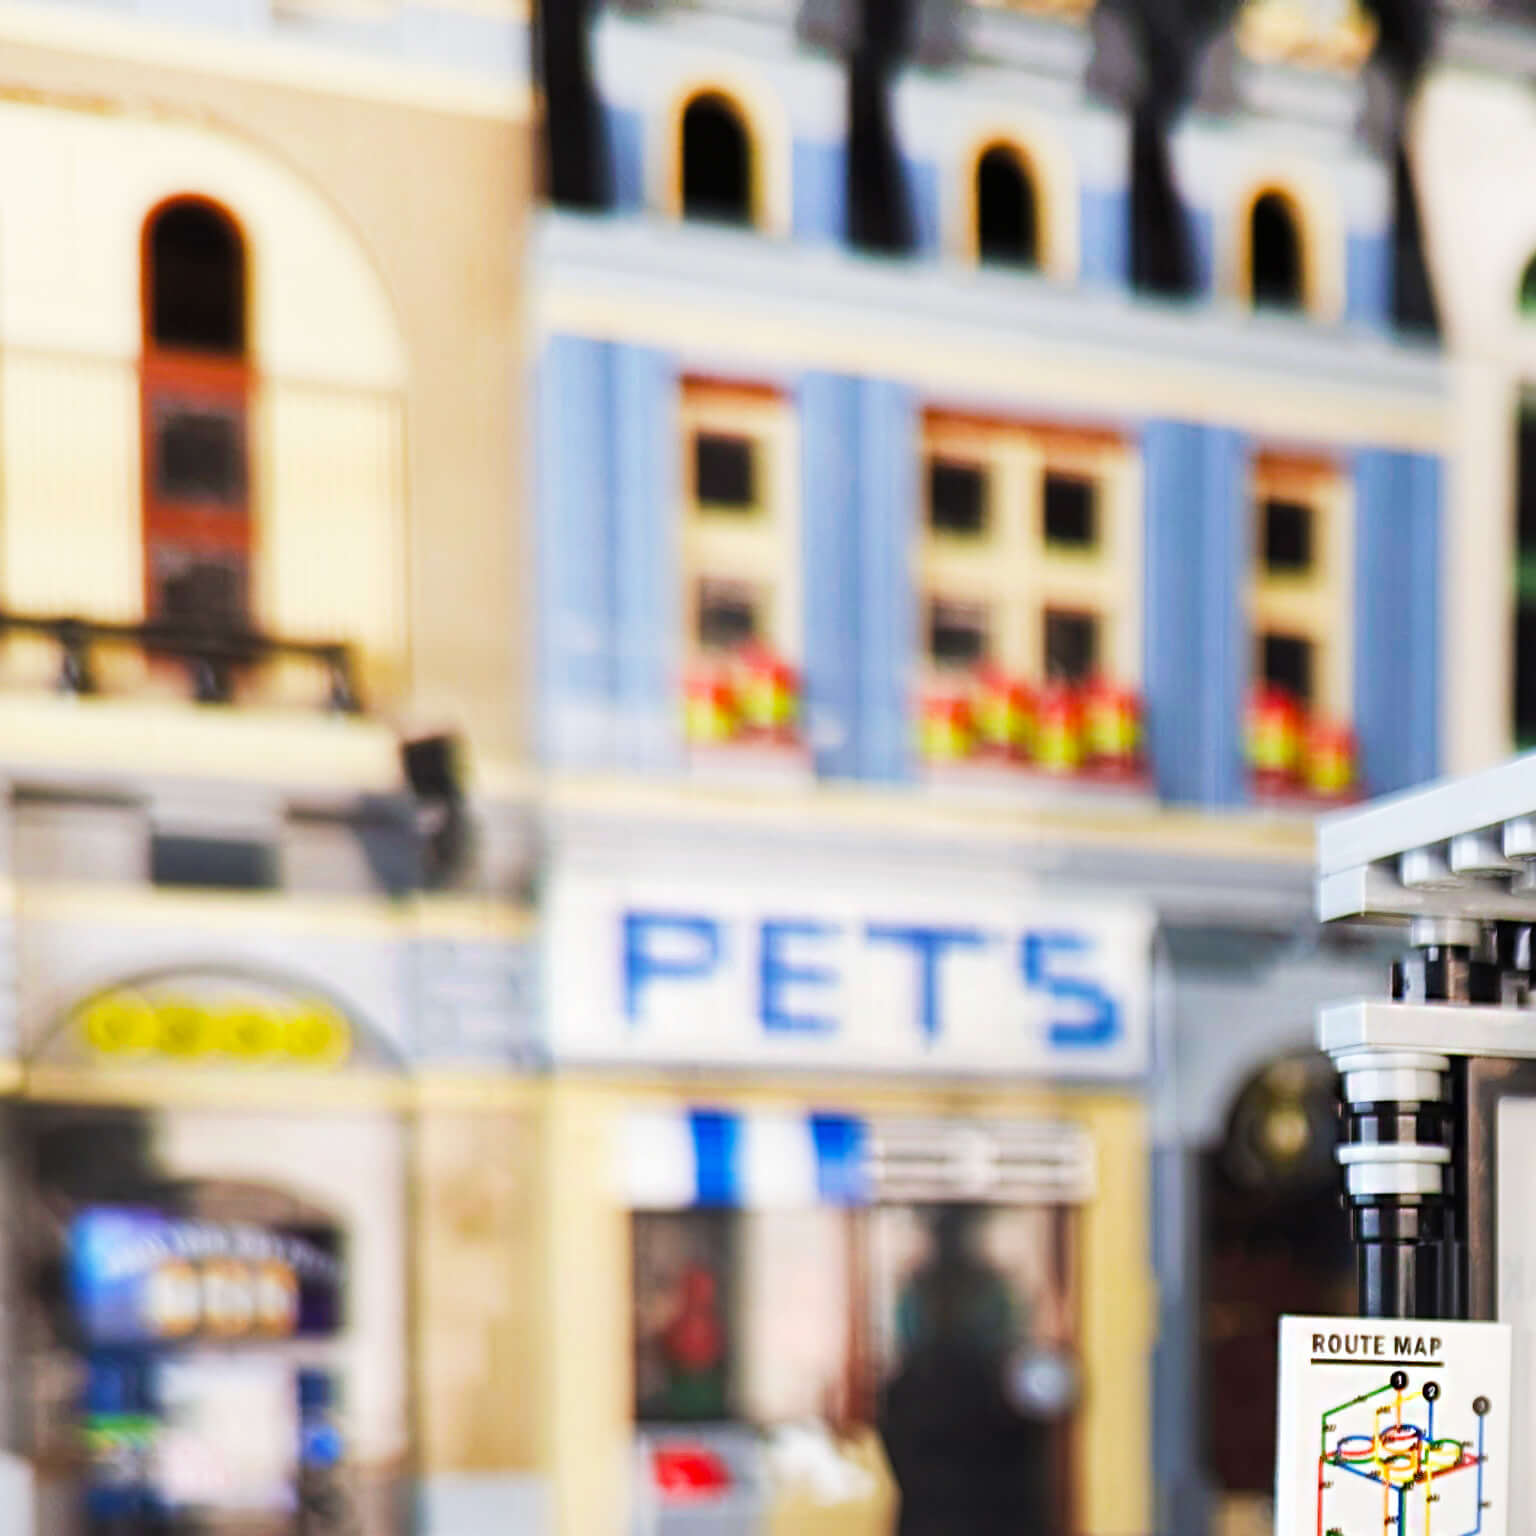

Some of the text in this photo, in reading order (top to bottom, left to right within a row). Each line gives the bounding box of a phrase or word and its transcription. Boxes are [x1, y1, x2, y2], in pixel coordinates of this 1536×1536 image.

[621, 909, 1125, 1050] PETS
[1311, 1332, 1443, 1357] ROUTE MAP
